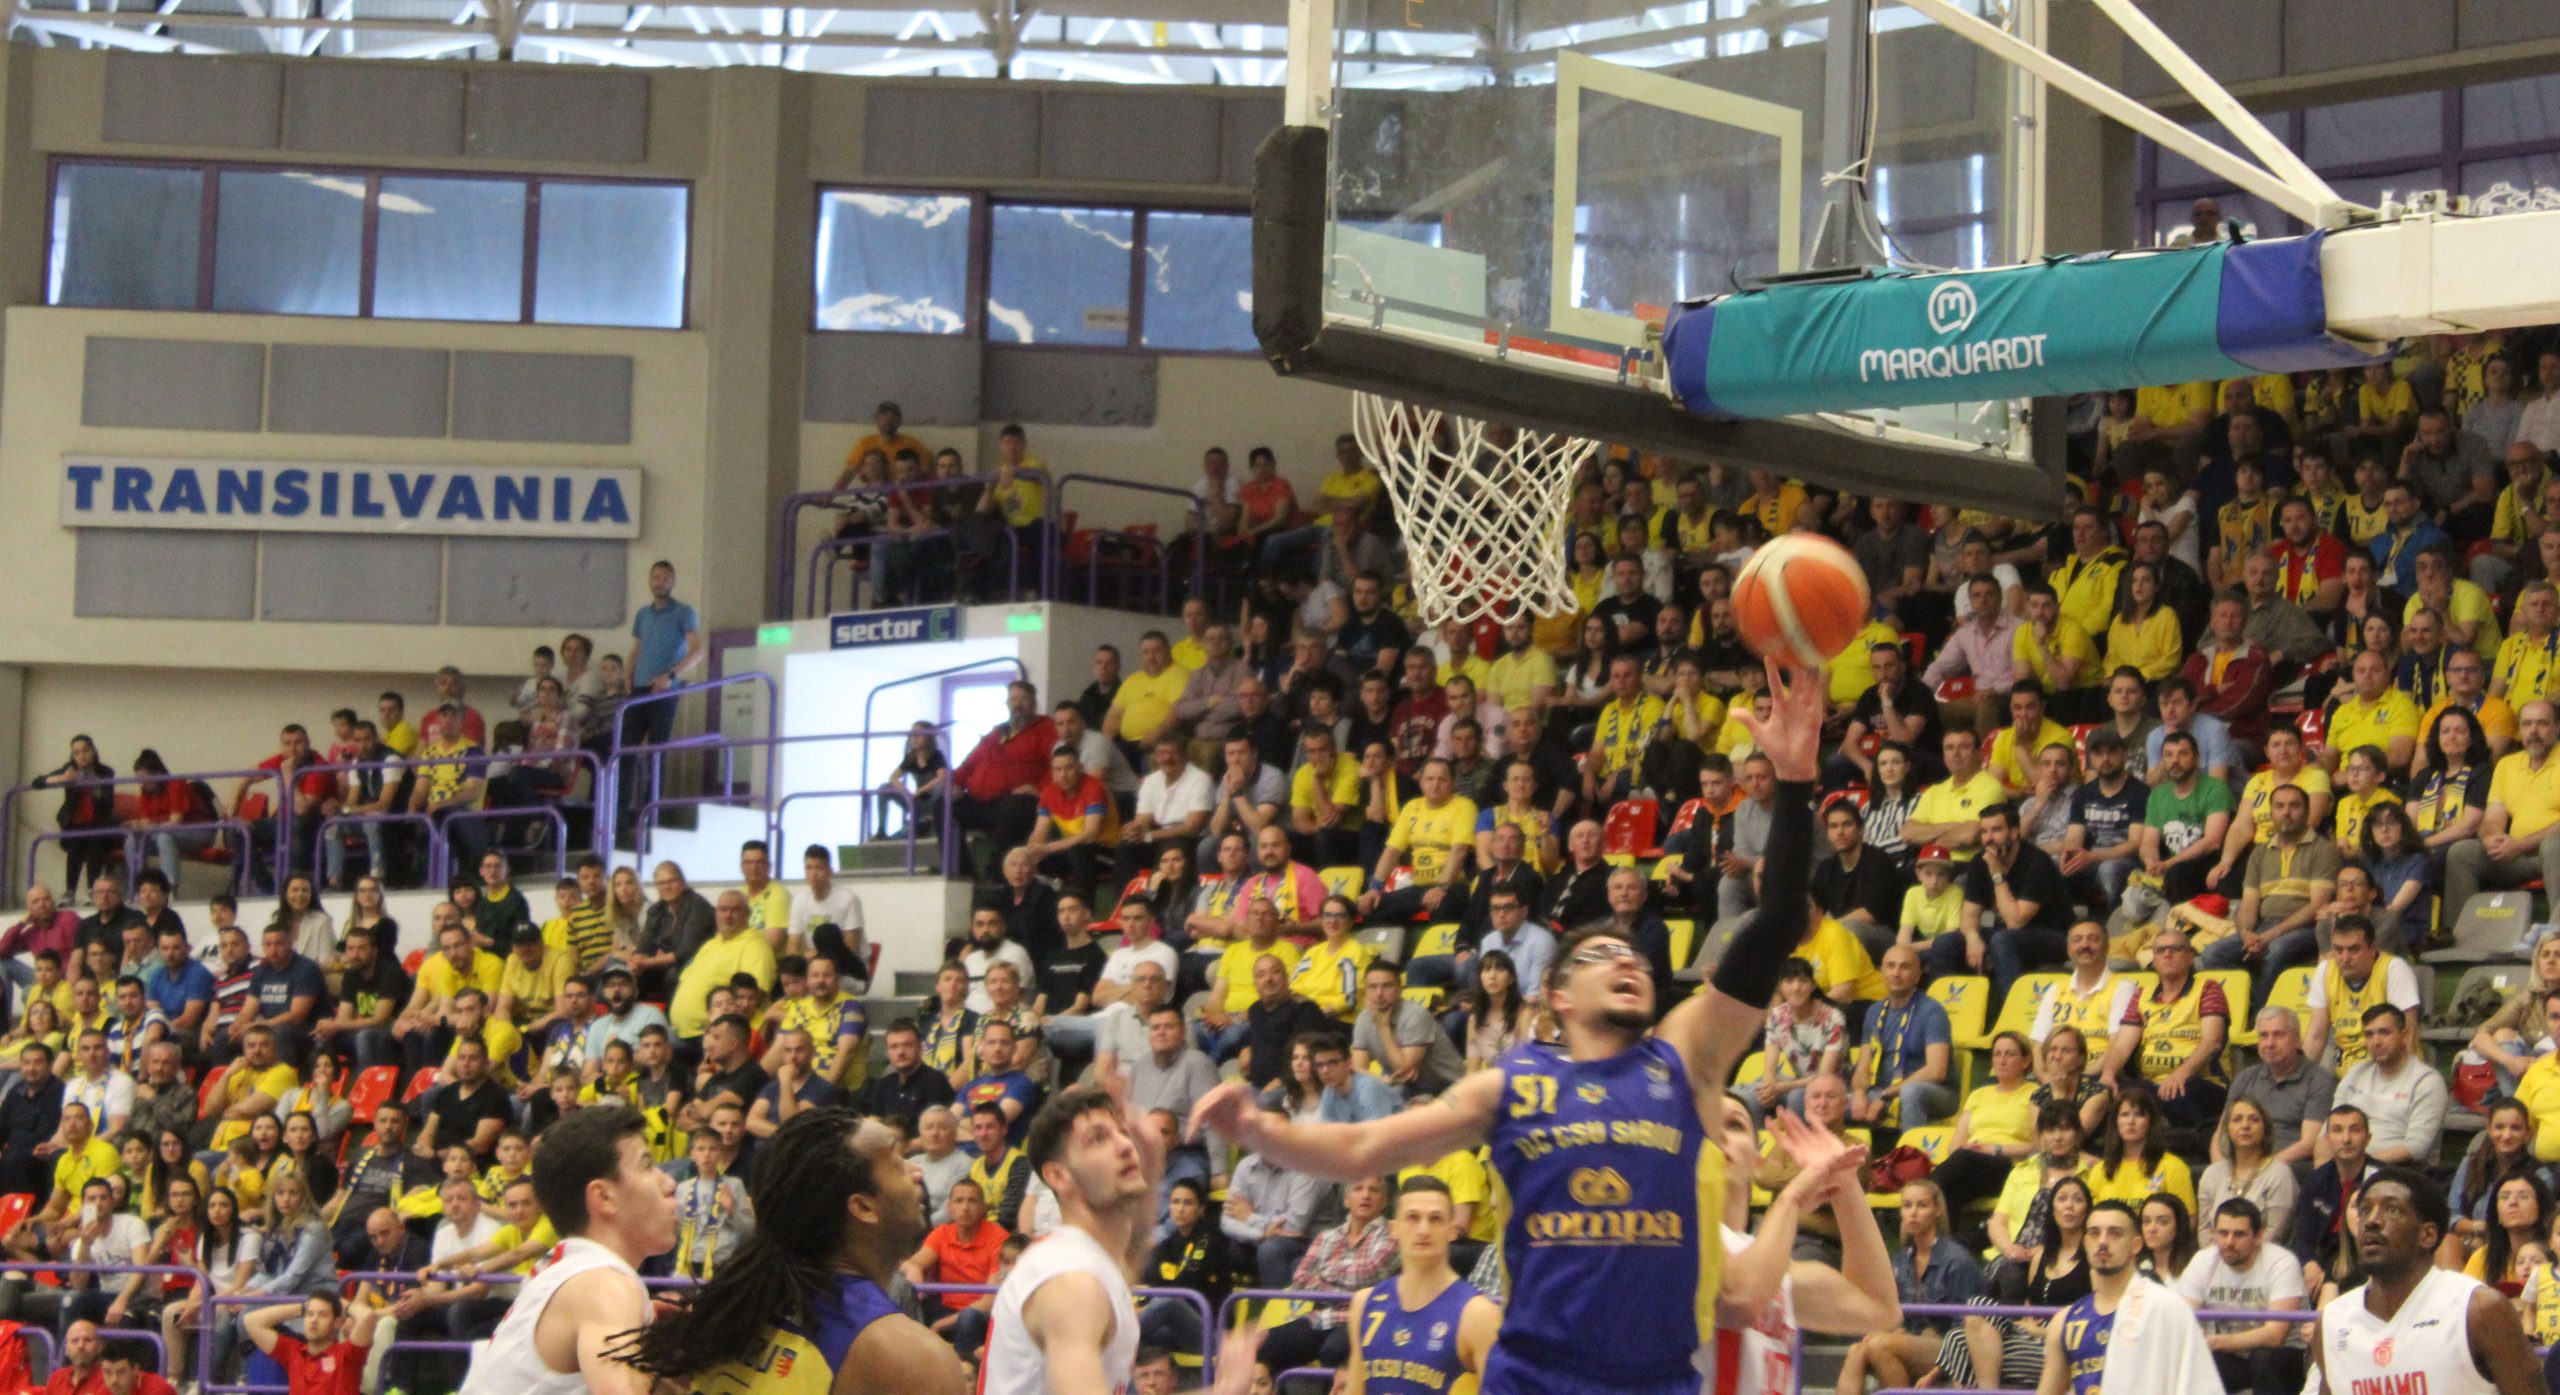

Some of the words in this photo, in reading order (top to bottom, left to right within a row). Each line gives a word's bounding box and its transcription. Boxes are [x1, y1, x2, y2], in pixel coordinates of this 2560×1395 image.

[1859, 333, 2048, 383] MARQUARDT
[66, 465, 630, 524] TRANSILVANIA
[835, 617, 923, 645] sector
[928, 607, 950, 641] C
[2051, 1001, 2073, 1023] 23
[1525, 1209, 1683, 1244] compa
[1361, 1310, 1388, 1348] 7
[2065, 1318, 2090, 1351] 17
